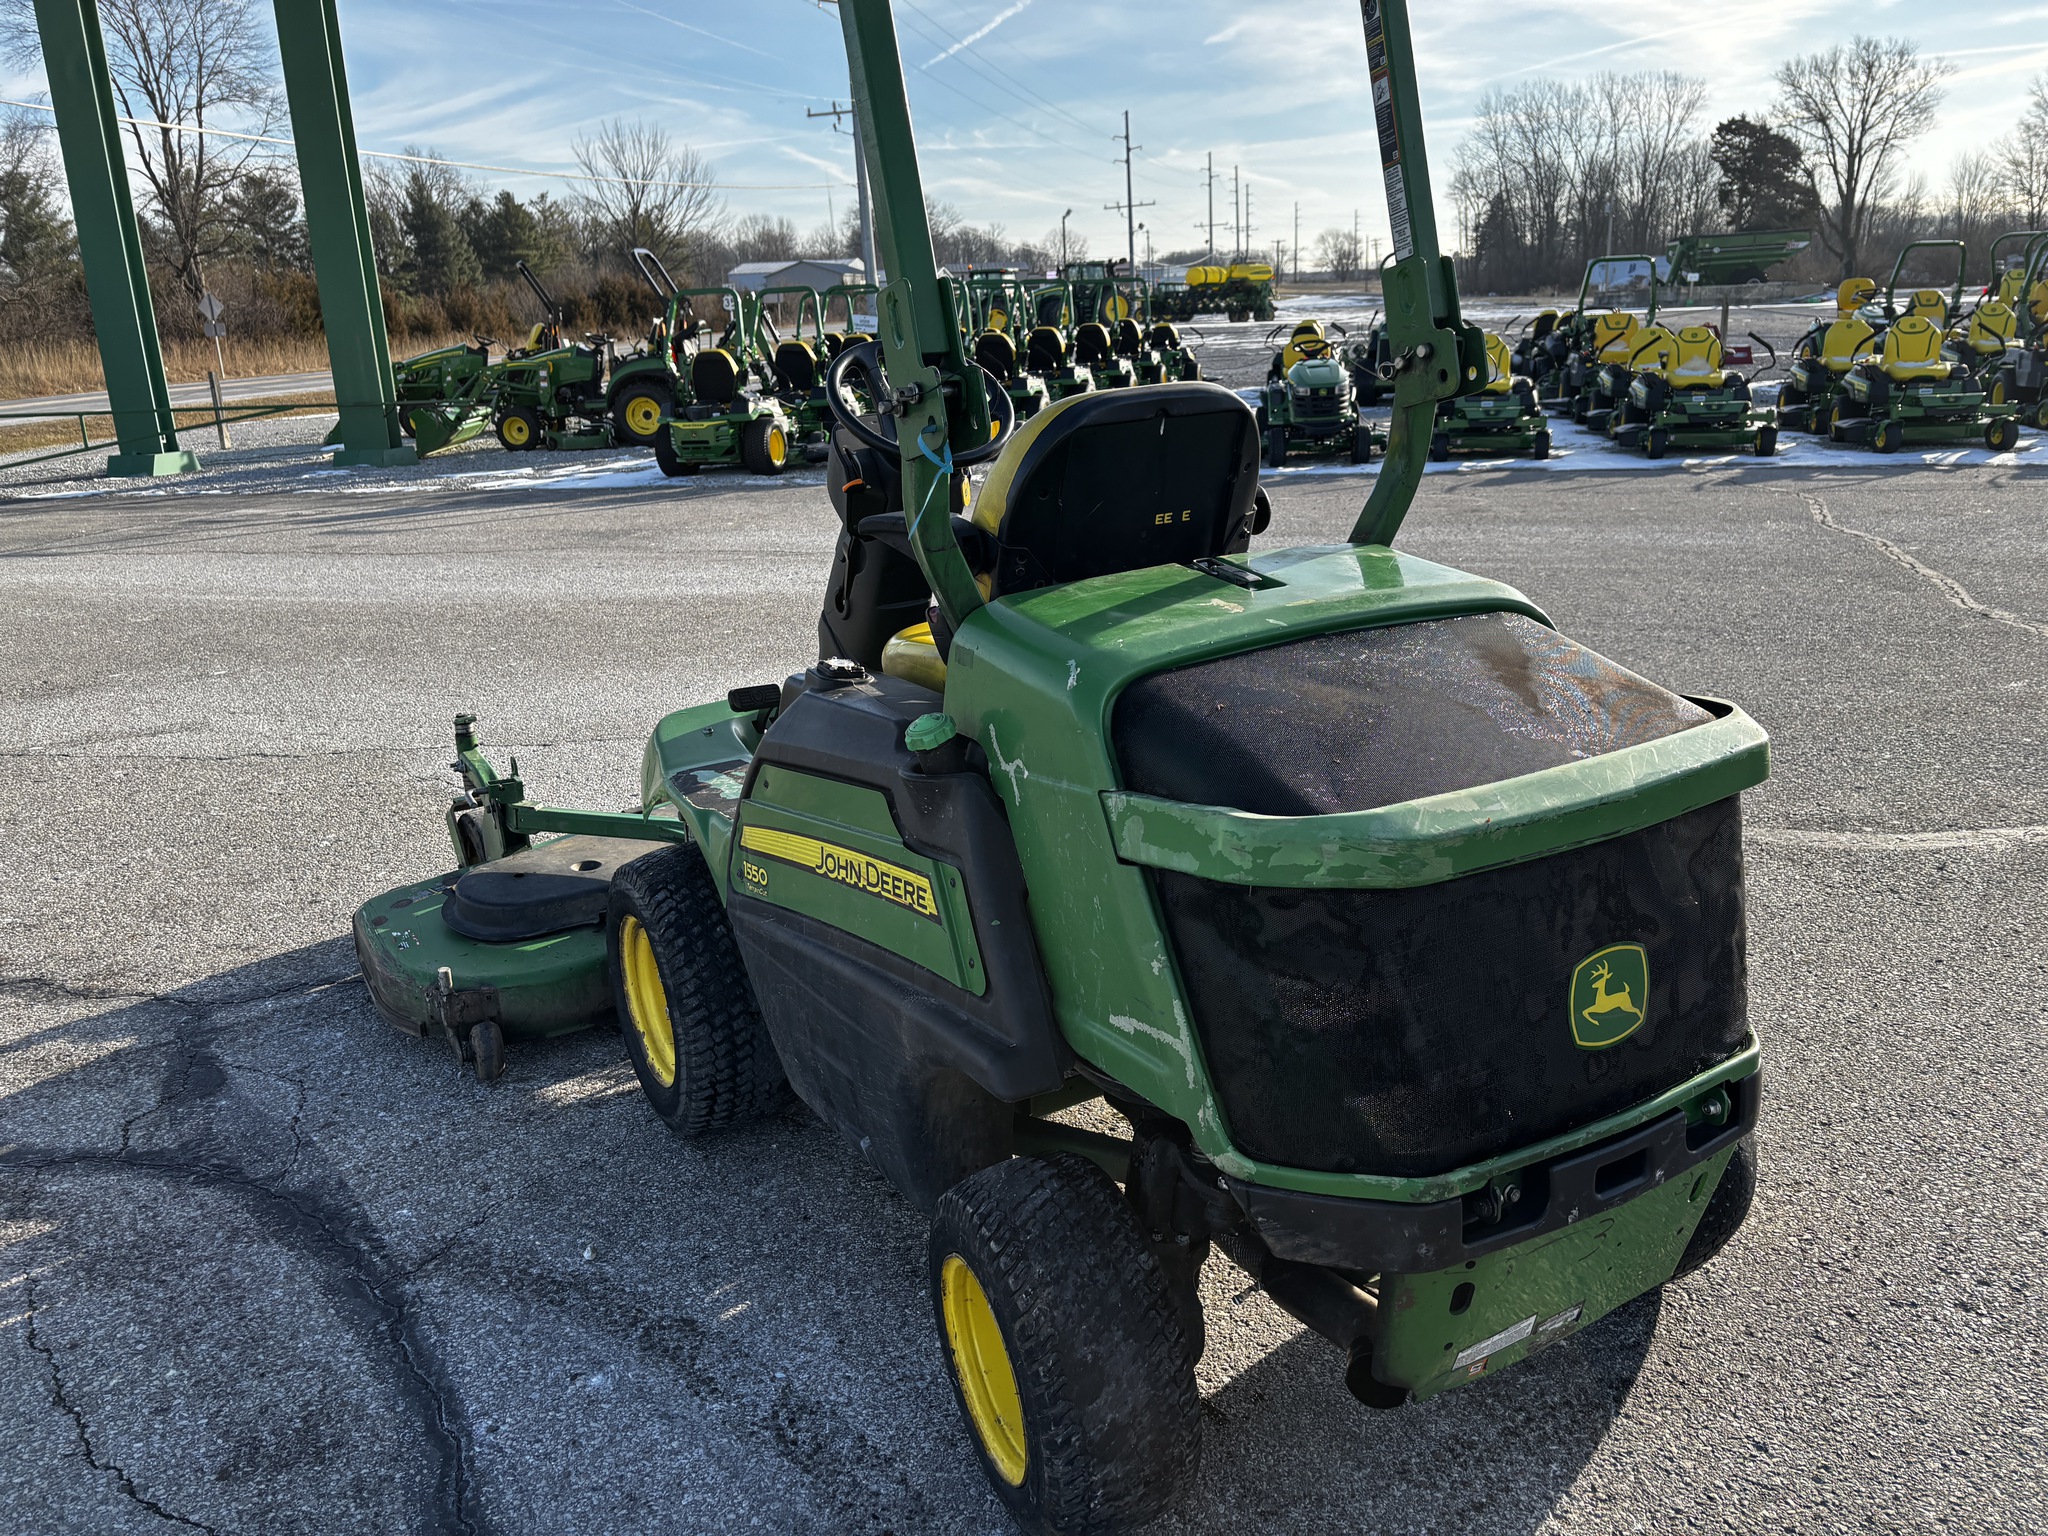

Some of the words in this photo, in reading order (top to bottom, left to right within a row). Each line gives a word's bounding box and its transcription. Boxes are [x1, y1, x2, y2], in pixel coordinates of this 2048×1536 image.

[743, 860, 768, 886] 1550
[815, 846, 862, 886] JOHN
[865, 860, 930, 914] DEERE
